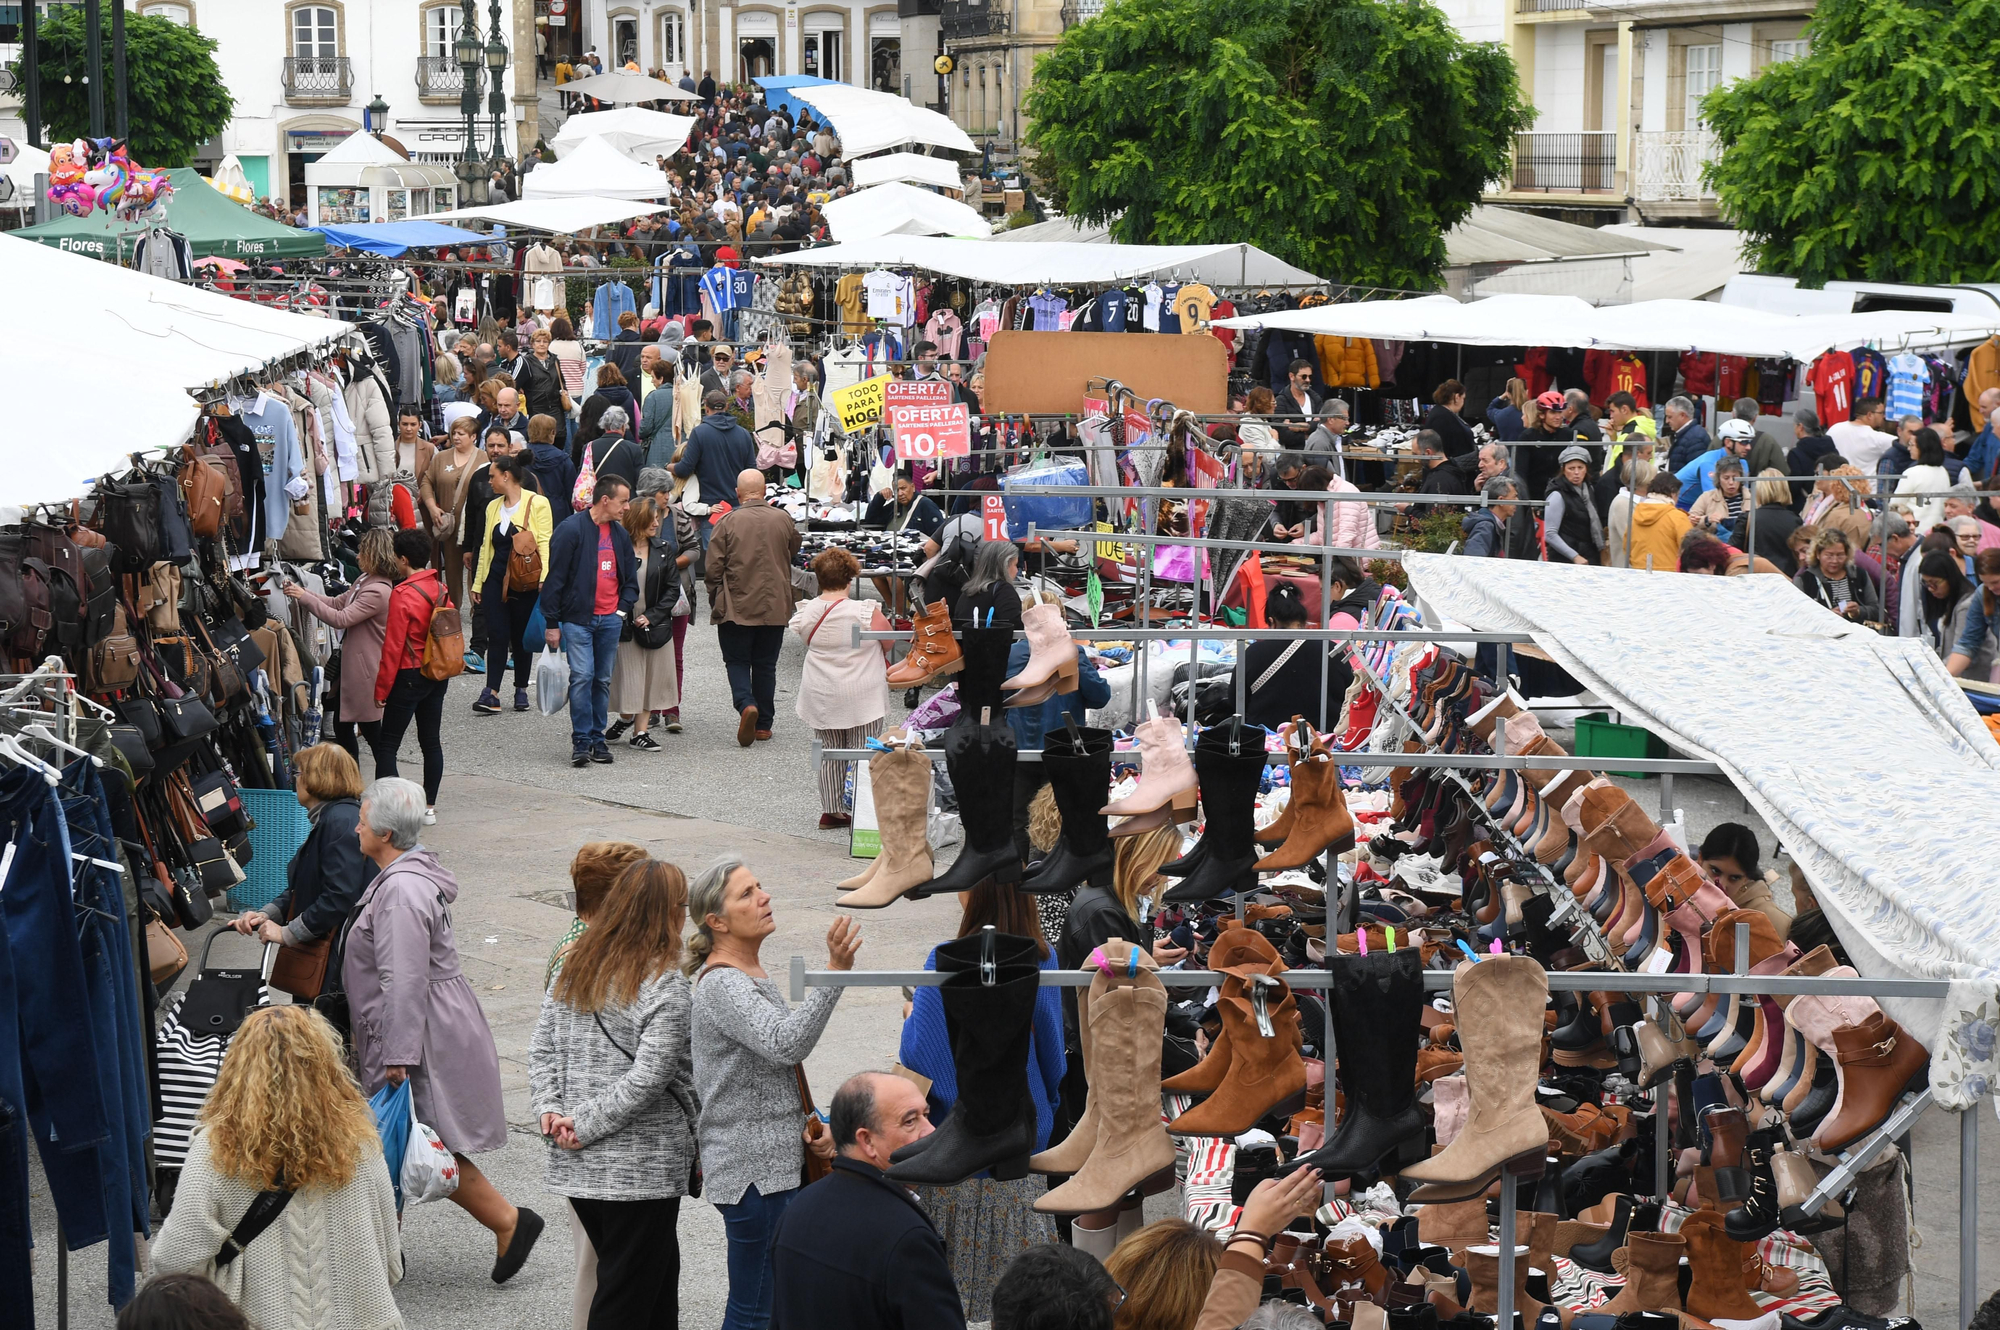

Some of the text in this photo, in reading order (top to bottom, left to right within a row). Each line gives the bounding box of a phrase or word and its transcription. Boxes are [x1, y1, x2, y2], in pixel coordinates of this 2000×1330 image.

[59, 238, 104, 252] Flores
[237, 240, 264, 253] Flores
[733, 281, 747, 294] 30
[1108, 306, 1117, 323] 7
[1127, 303, 1139, 322] 20
[1188, 303, 1199, 327] 9
[887, 383, 947, 395] OFERTA
[1617, 374, 1632, 393] 10
[1861, 368, 1872, 394] 9
[848, 383, 879, 400] TODO
[846, 395, 876, 412] PARA
[897, 406, 964, 422] OFERTA
[929, 419, 964, 428] PAELLERAS
[601, 561, 612, 570] 86
